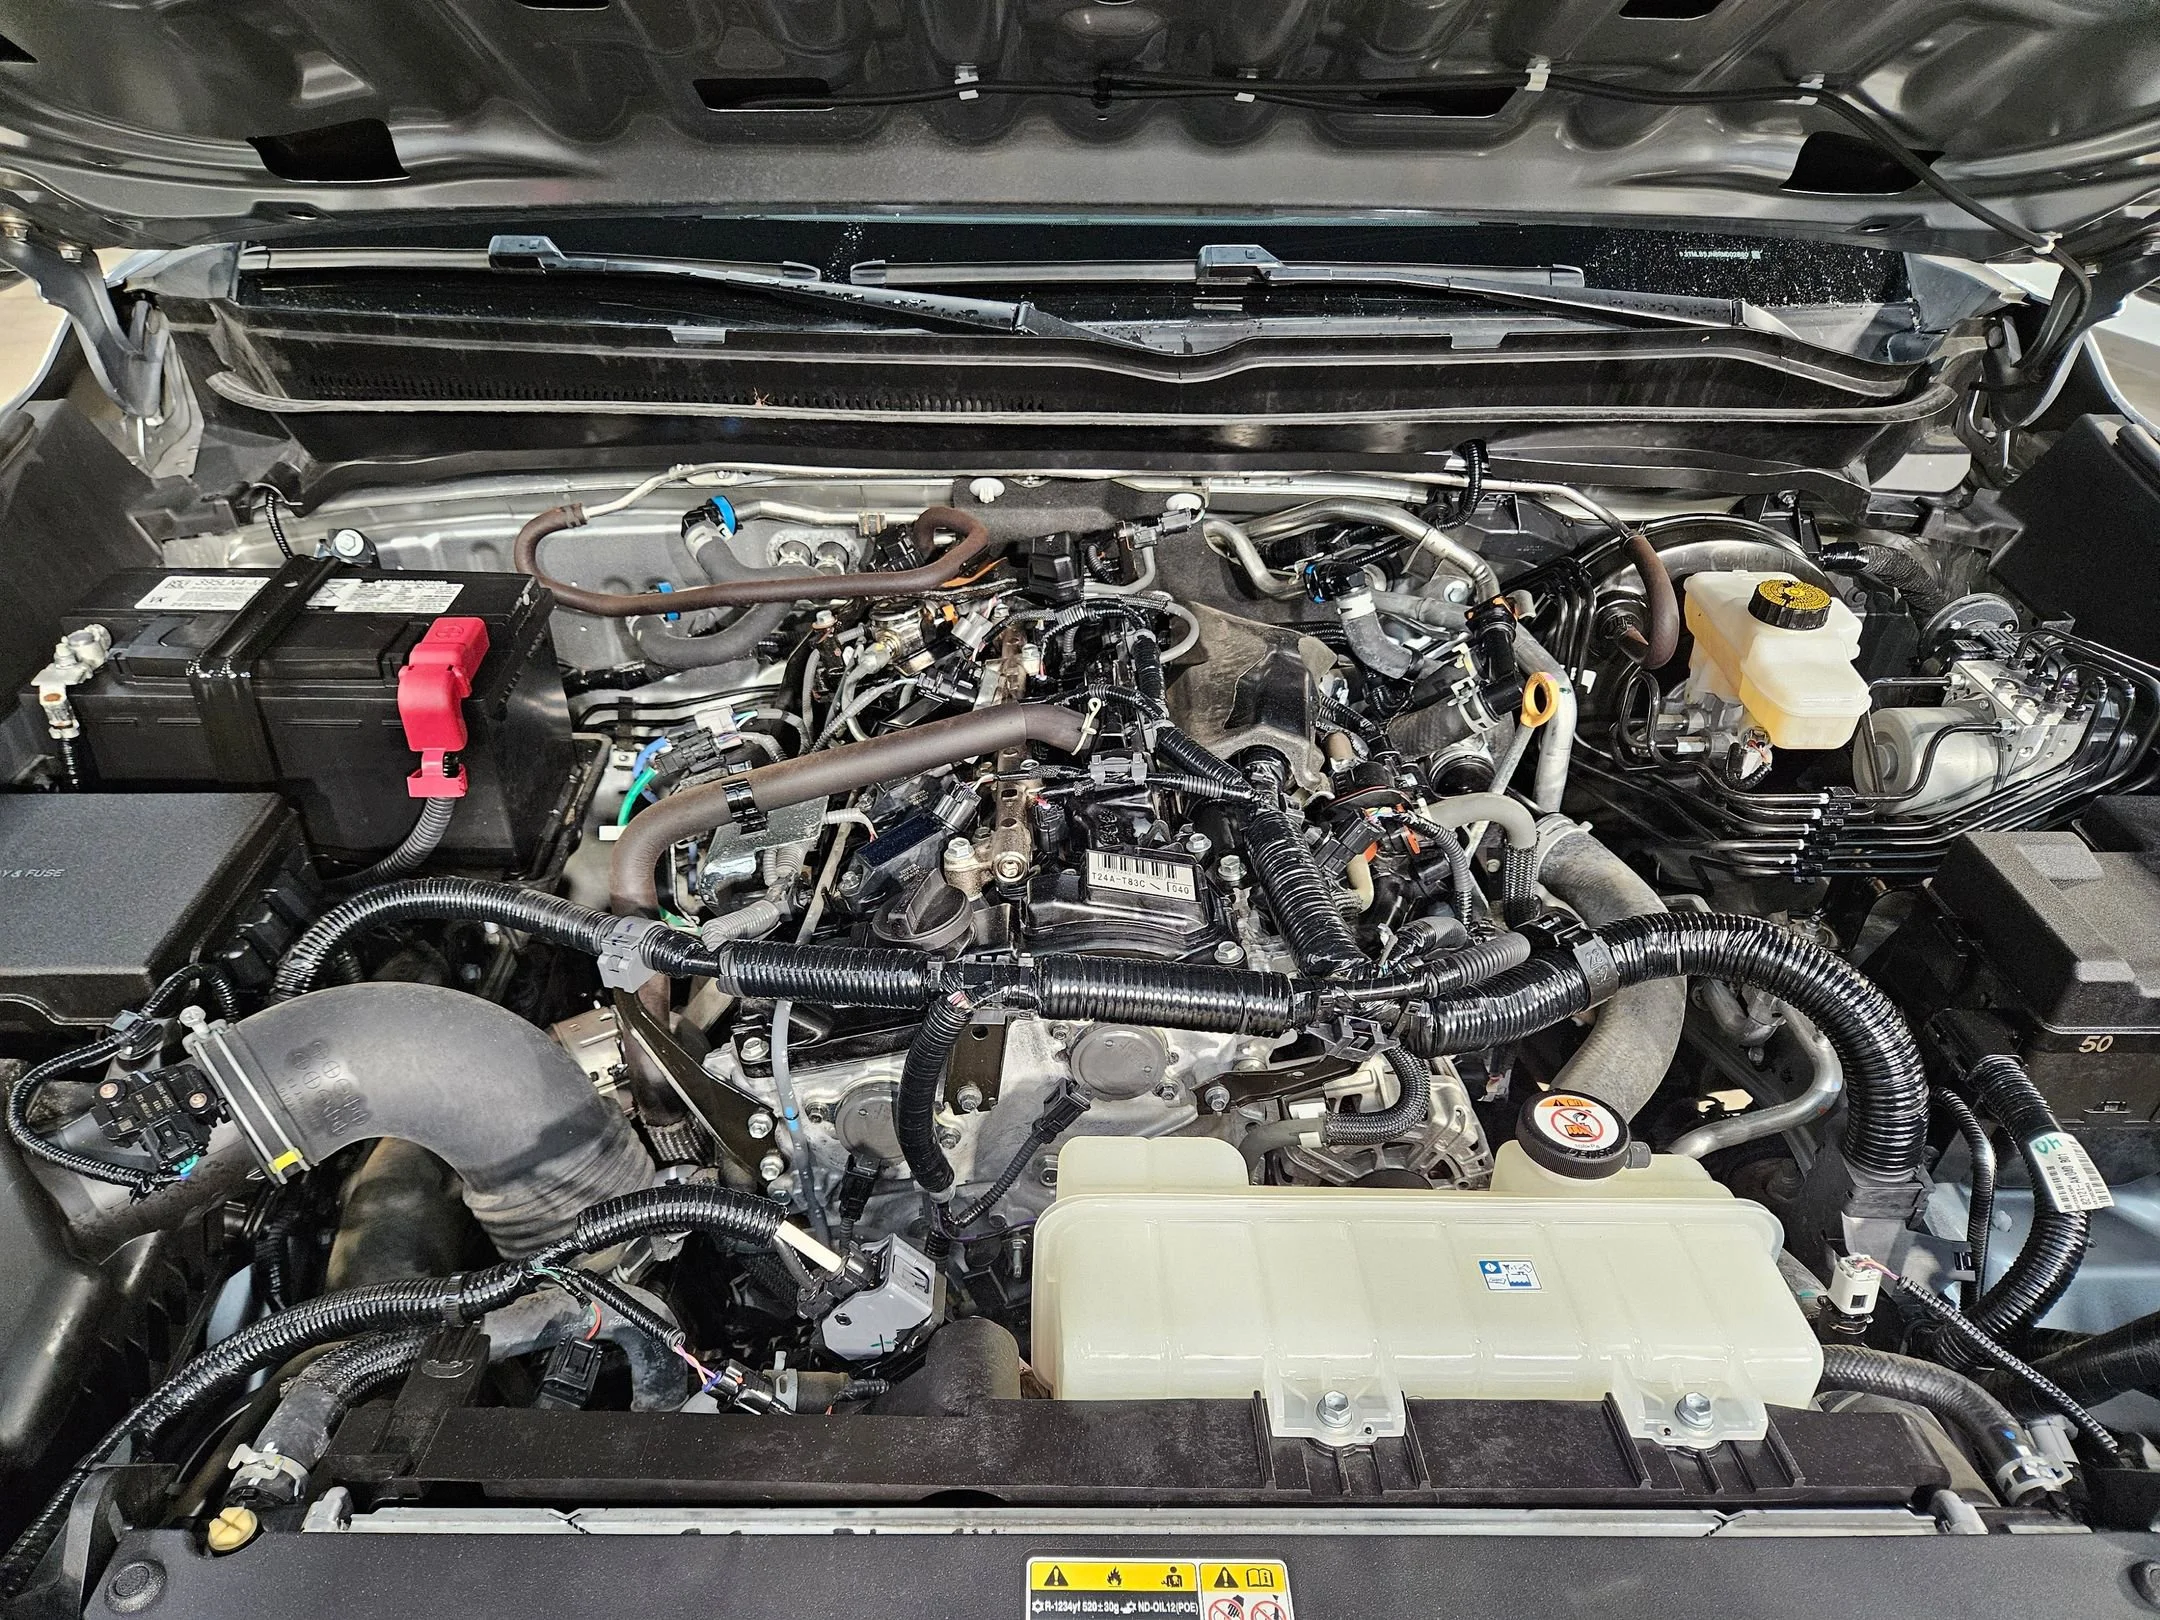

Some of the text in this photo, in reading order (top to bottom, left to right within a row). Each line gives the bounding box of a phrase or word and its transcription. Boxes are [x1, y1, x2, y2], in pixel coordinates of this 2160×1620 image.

[25, 869, 65, 878] FUSE
[1092, 872, 1146, 888] T24A-T83C
[2078, 1035, 2114, 1053] 50
[1044, 1600, 1080, 1614] R-1234yf
[1138, 1600, 1199, 1615] ND-OIL12(POE)
